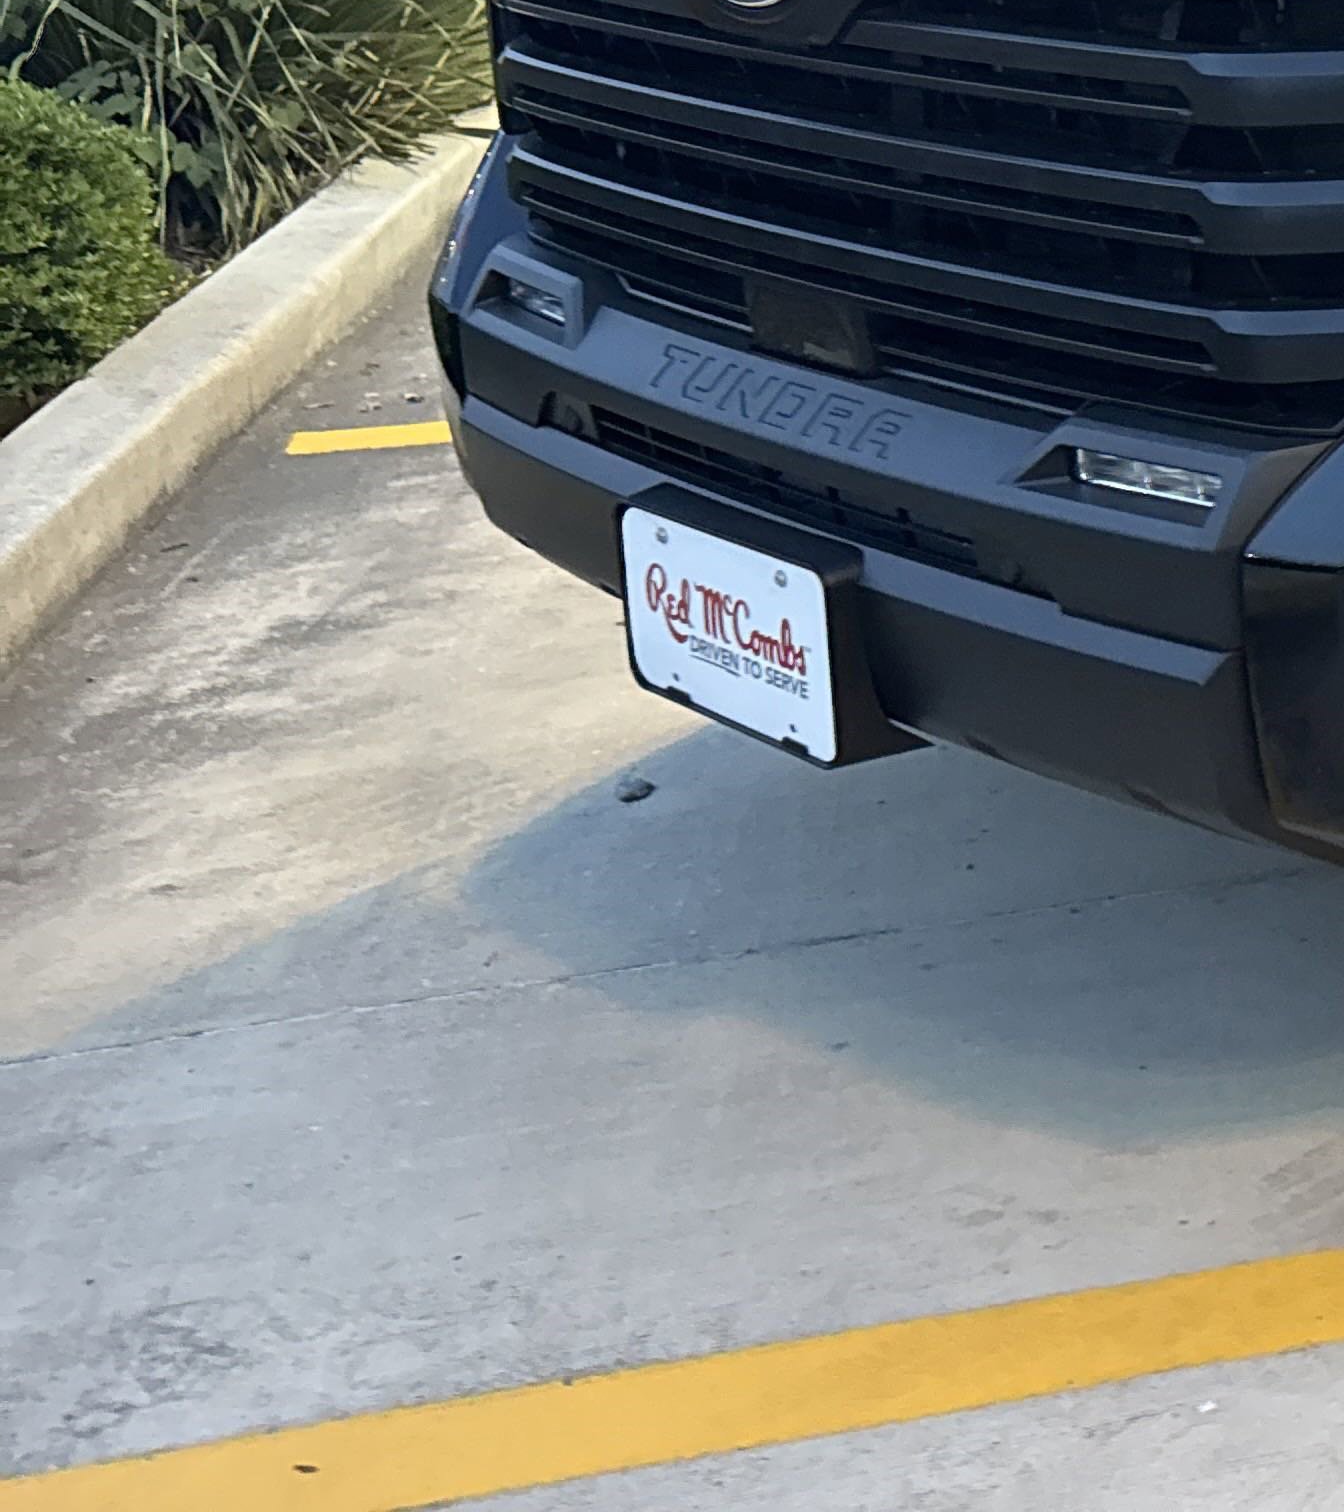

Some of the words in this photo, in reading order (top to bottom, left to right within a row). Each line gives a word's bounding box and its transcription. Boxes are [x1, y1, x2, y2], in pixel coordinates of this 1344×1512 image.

[648, 342, 914, 461] TUNDRA
[645, 562, 694, 644] Red
[694, 582, 808, 677] McCombs
[689, 634, 740, 671] DRIVEN
[742, 656, 763, 679] TO
[764, 666, 810, 701] SERVE
